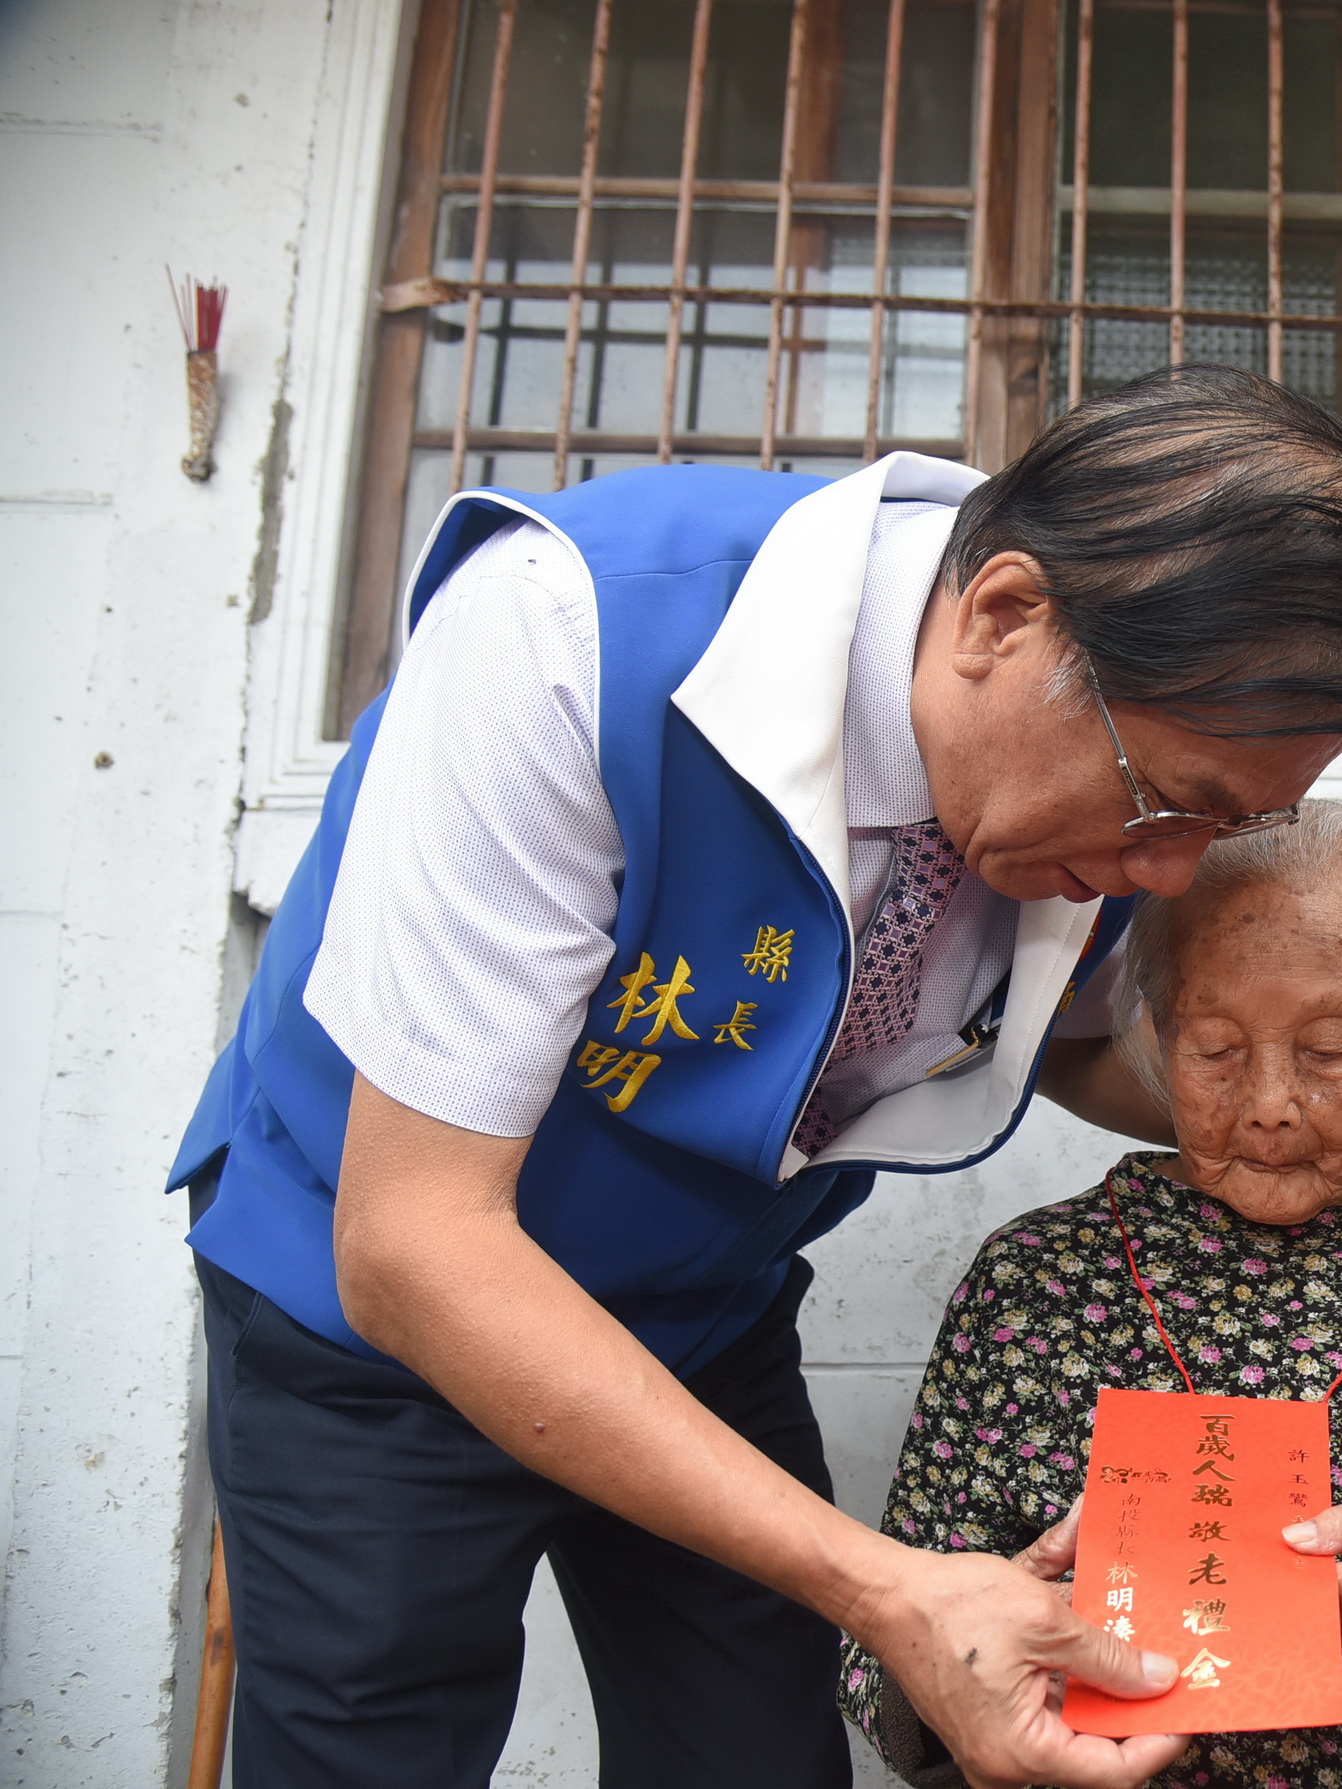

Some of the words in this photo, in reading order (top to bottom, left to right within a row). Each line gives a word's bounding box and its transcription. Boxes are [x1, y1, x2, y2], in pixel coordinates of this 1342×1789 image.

[576, 951, 700, 1113] 林明
[712, 925, 795, 1050] 縣長
[1181, 1414, 1236, 1689] 百歲人瑞敬老禮金
